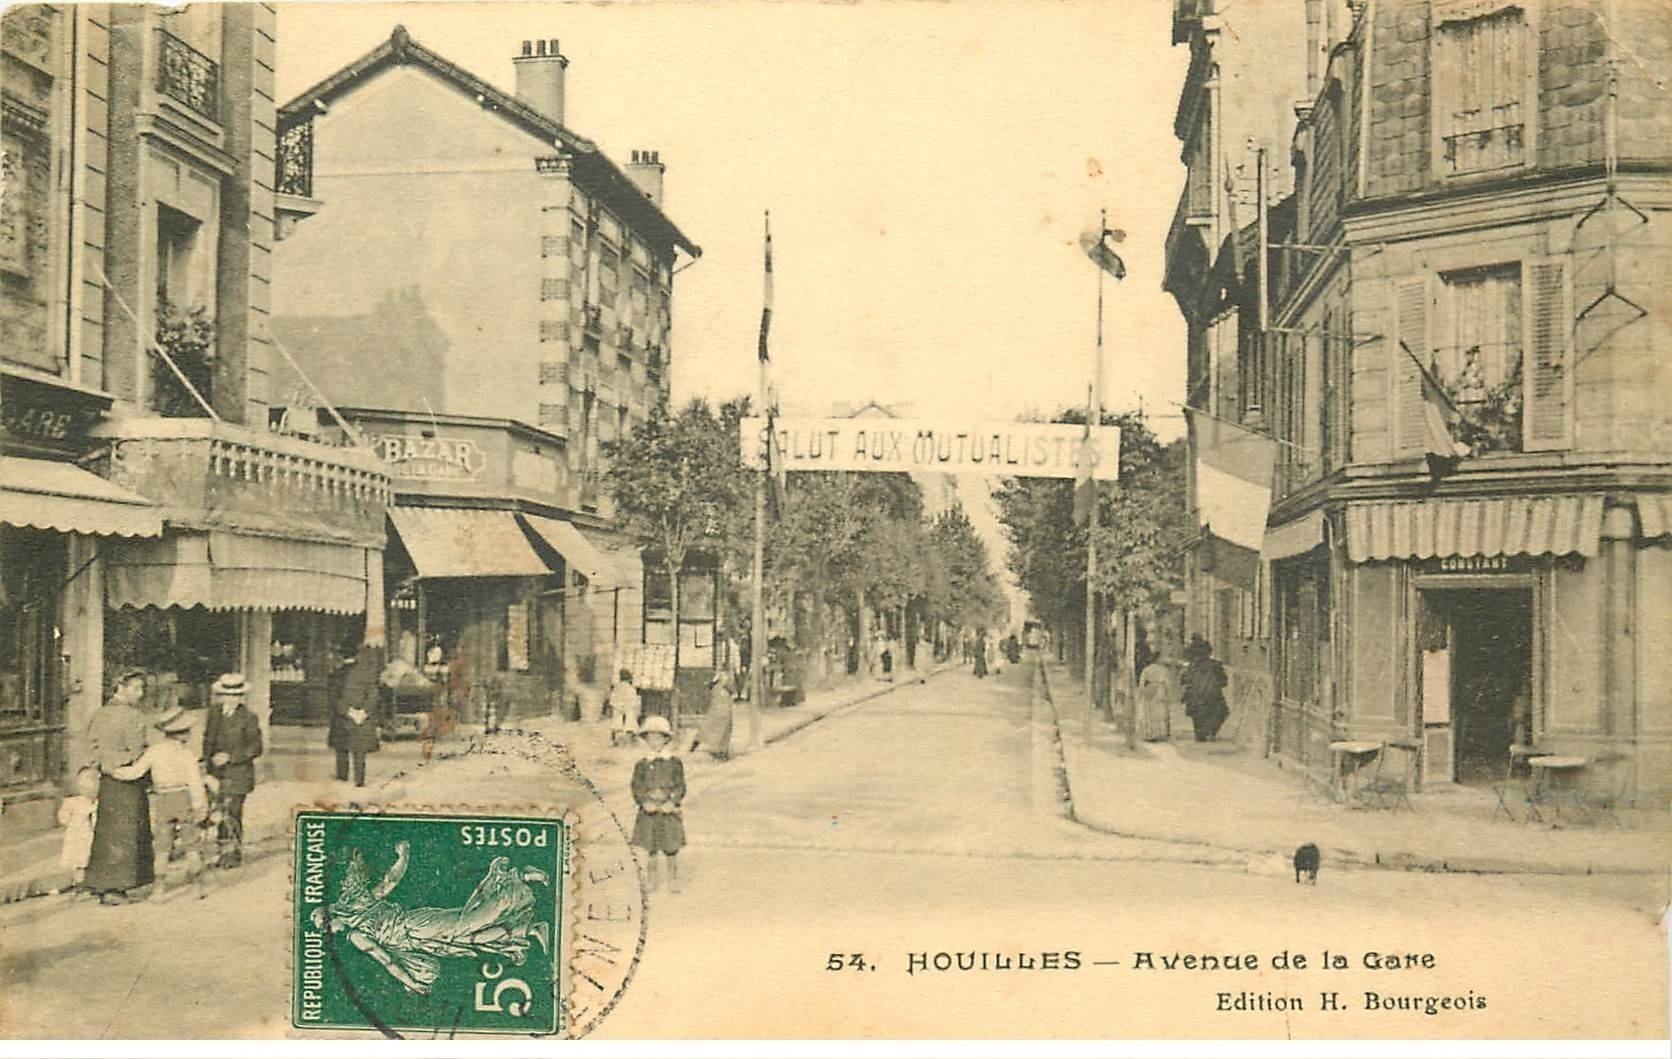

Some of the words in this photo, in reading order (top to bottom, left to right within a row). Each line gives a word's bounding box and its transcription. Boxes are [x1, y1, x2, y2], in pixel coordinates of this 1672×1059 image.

[384, 439, 472, 471] BAZAR
[854, 429, 902, 461] AUX
[460, 825, 548, 848] POSTES
[304, 821, 326, 903] FRANÇAISE
[303, 929, 323, 1021] REPUBLIQUE
